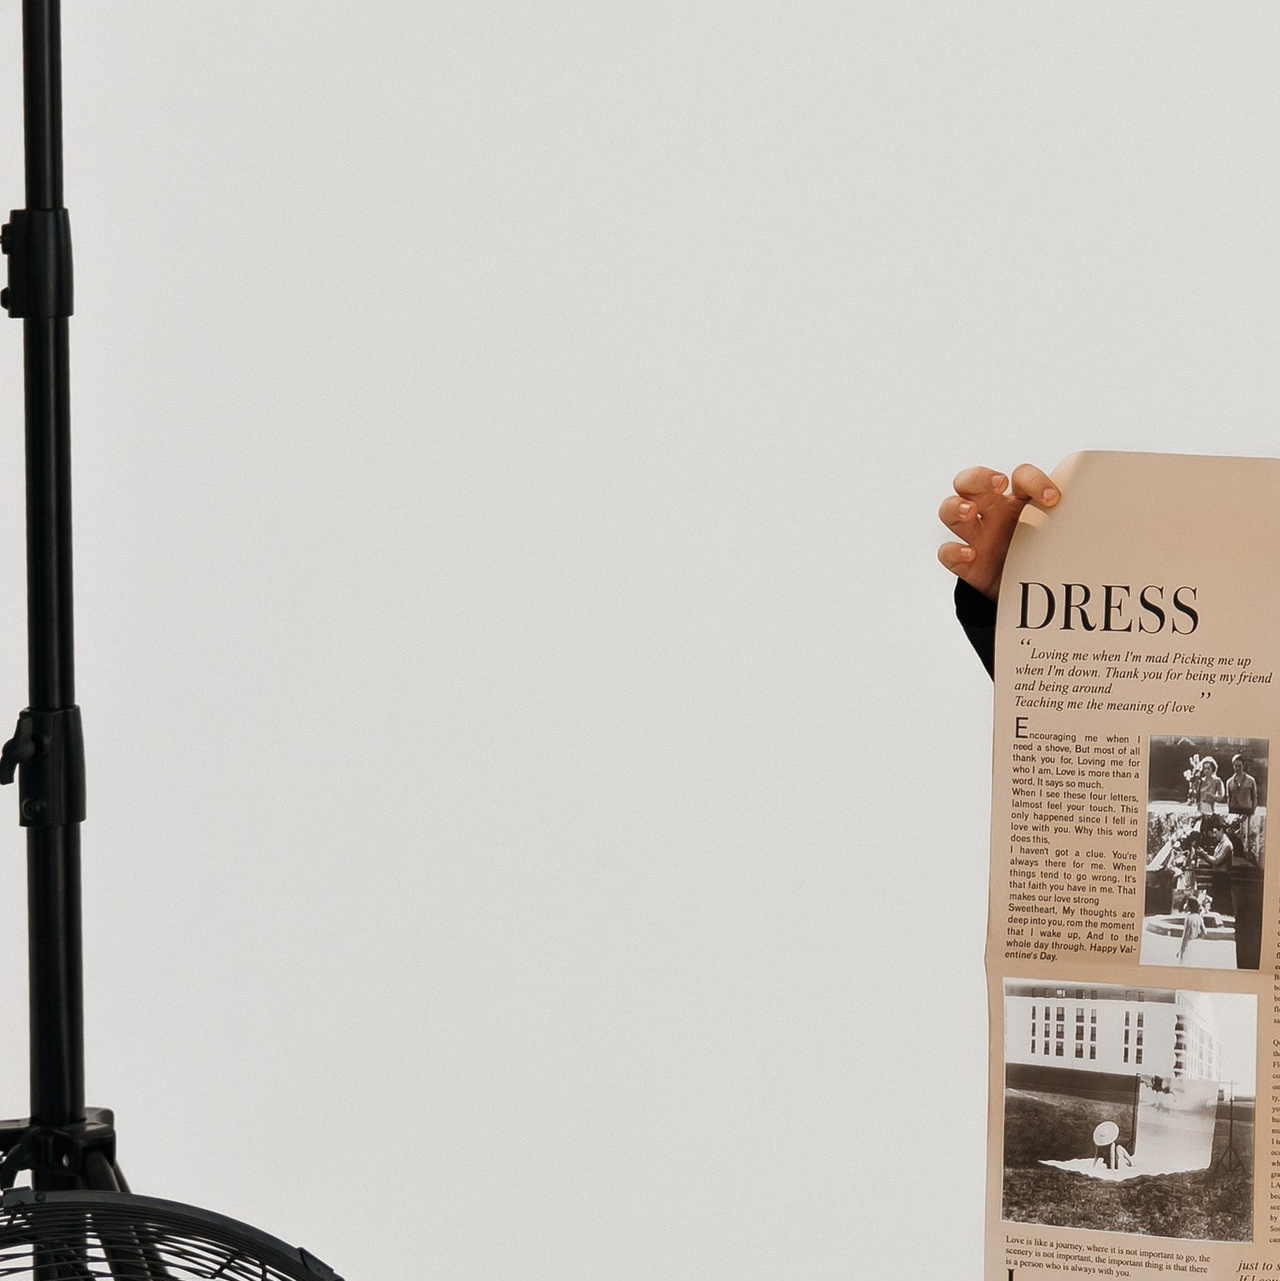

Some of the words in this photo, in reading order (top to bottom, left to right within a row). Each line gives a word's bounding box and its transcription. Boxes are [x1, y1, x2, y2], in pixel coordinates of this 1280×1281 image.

[1016, 582, 1200, 636] DRESS
[1030, 648, 1069, 663] Loving
[1072, 653, 1089, 661] me
[1092, 650, 1121, 662] when
[1124, 651, 1142, 662] I'm
[1145, 652, 1170, 664] mad
[1172, 653, 1215, 667] Picking
[1218, 658, 1234, 666] me
[1237, 658, 1252, 669] up
[1016, 664, 1044, 676] when
[1047, 665, 1065, 676] I'm
[1067, 665, 1100, 678] down.
[1106, 667, 1139, 679] Thank
[1141, 671, 1163, 682] you
[1164, 668, 1183, 683] for
[1185, 669, 1216, 684] being
[1219, 674, 1236, 685] my
[1236, 671, 1273, 685] friend
[1014, 680, 1036, 691] and
[1038, 680, 1069, 695] being
[1015, 695, 1064, 711] Teaching
[1067, 701, 1083, 709] me
[1086, 698, 1104, 710] the
[1106, 701, 1155, 714] meaning
[1157, 701, 1171, 715] of
[1172, 701, 1195, 713] love
[1015, 717, 1077, 743] Encouraging
[1106, 734, 1129, 743] when
[1138, 735, 1141, 743] I
[1013, 743, 1033, 751] need
[1075, 744, 1090, 754] But
[1093, 747, 1115, 755] most
[1118, 746, 1127, 755] of
[1129, 747, 1140, 755] all
[1236, 1260, 1259, 1273] just
[1262, 1262, 1273, 1271] to
